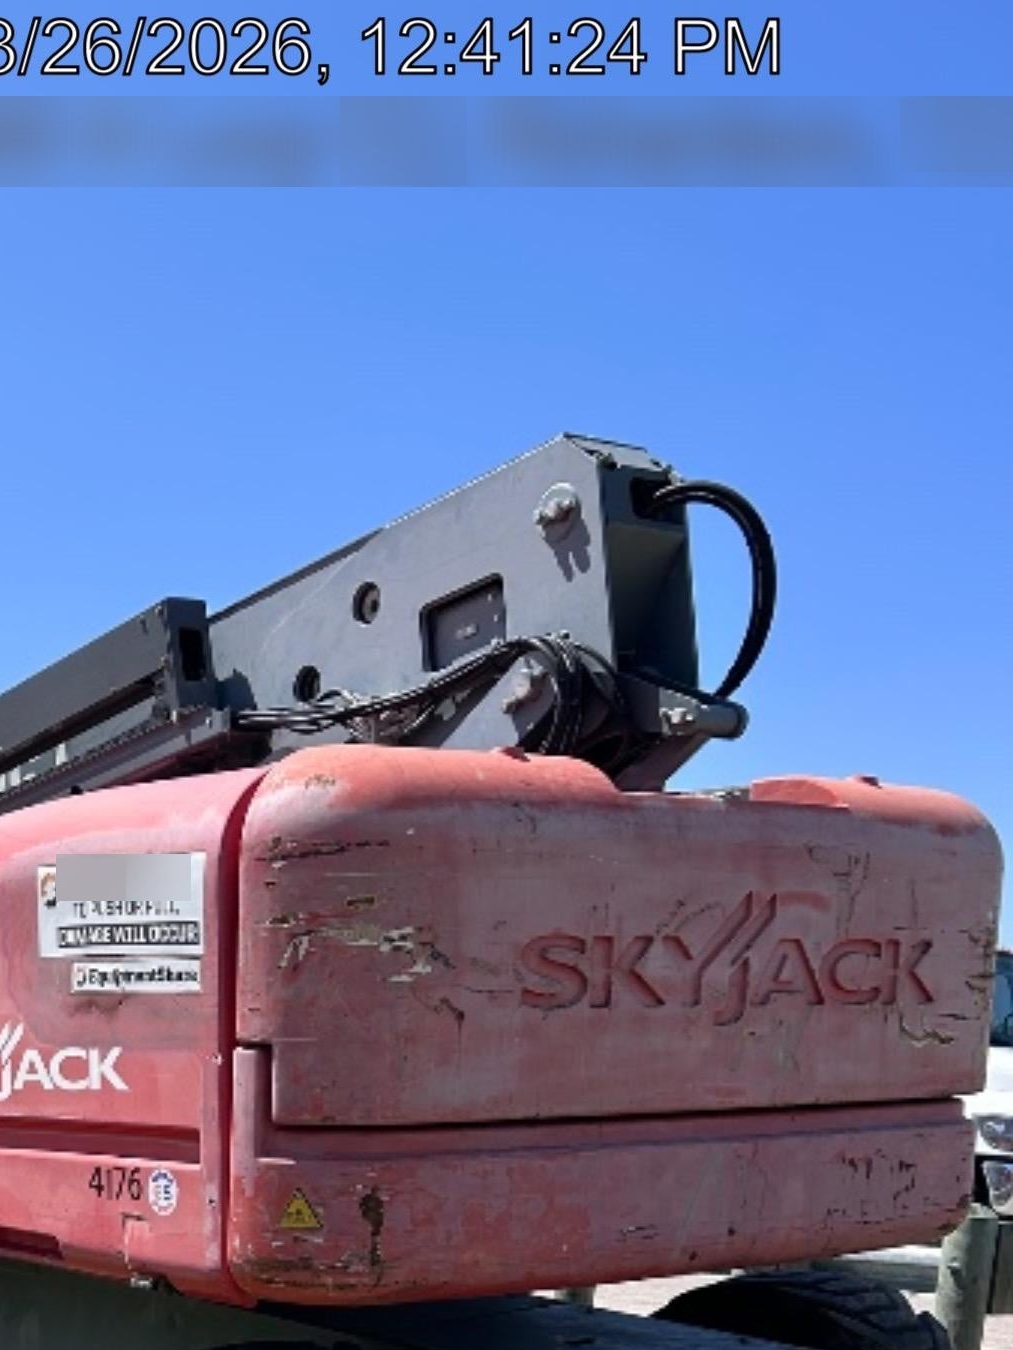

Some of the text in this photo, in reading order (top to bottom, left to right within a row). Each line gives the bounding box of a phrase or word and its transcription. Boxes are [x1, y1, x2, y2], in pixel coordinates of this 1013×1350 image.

[59, 921, 199, 946] DAMAGE WILL OCCUR
[520, 891, 935, 1026] SKYJACK
[89, 1166, 143, 1201] 4176
